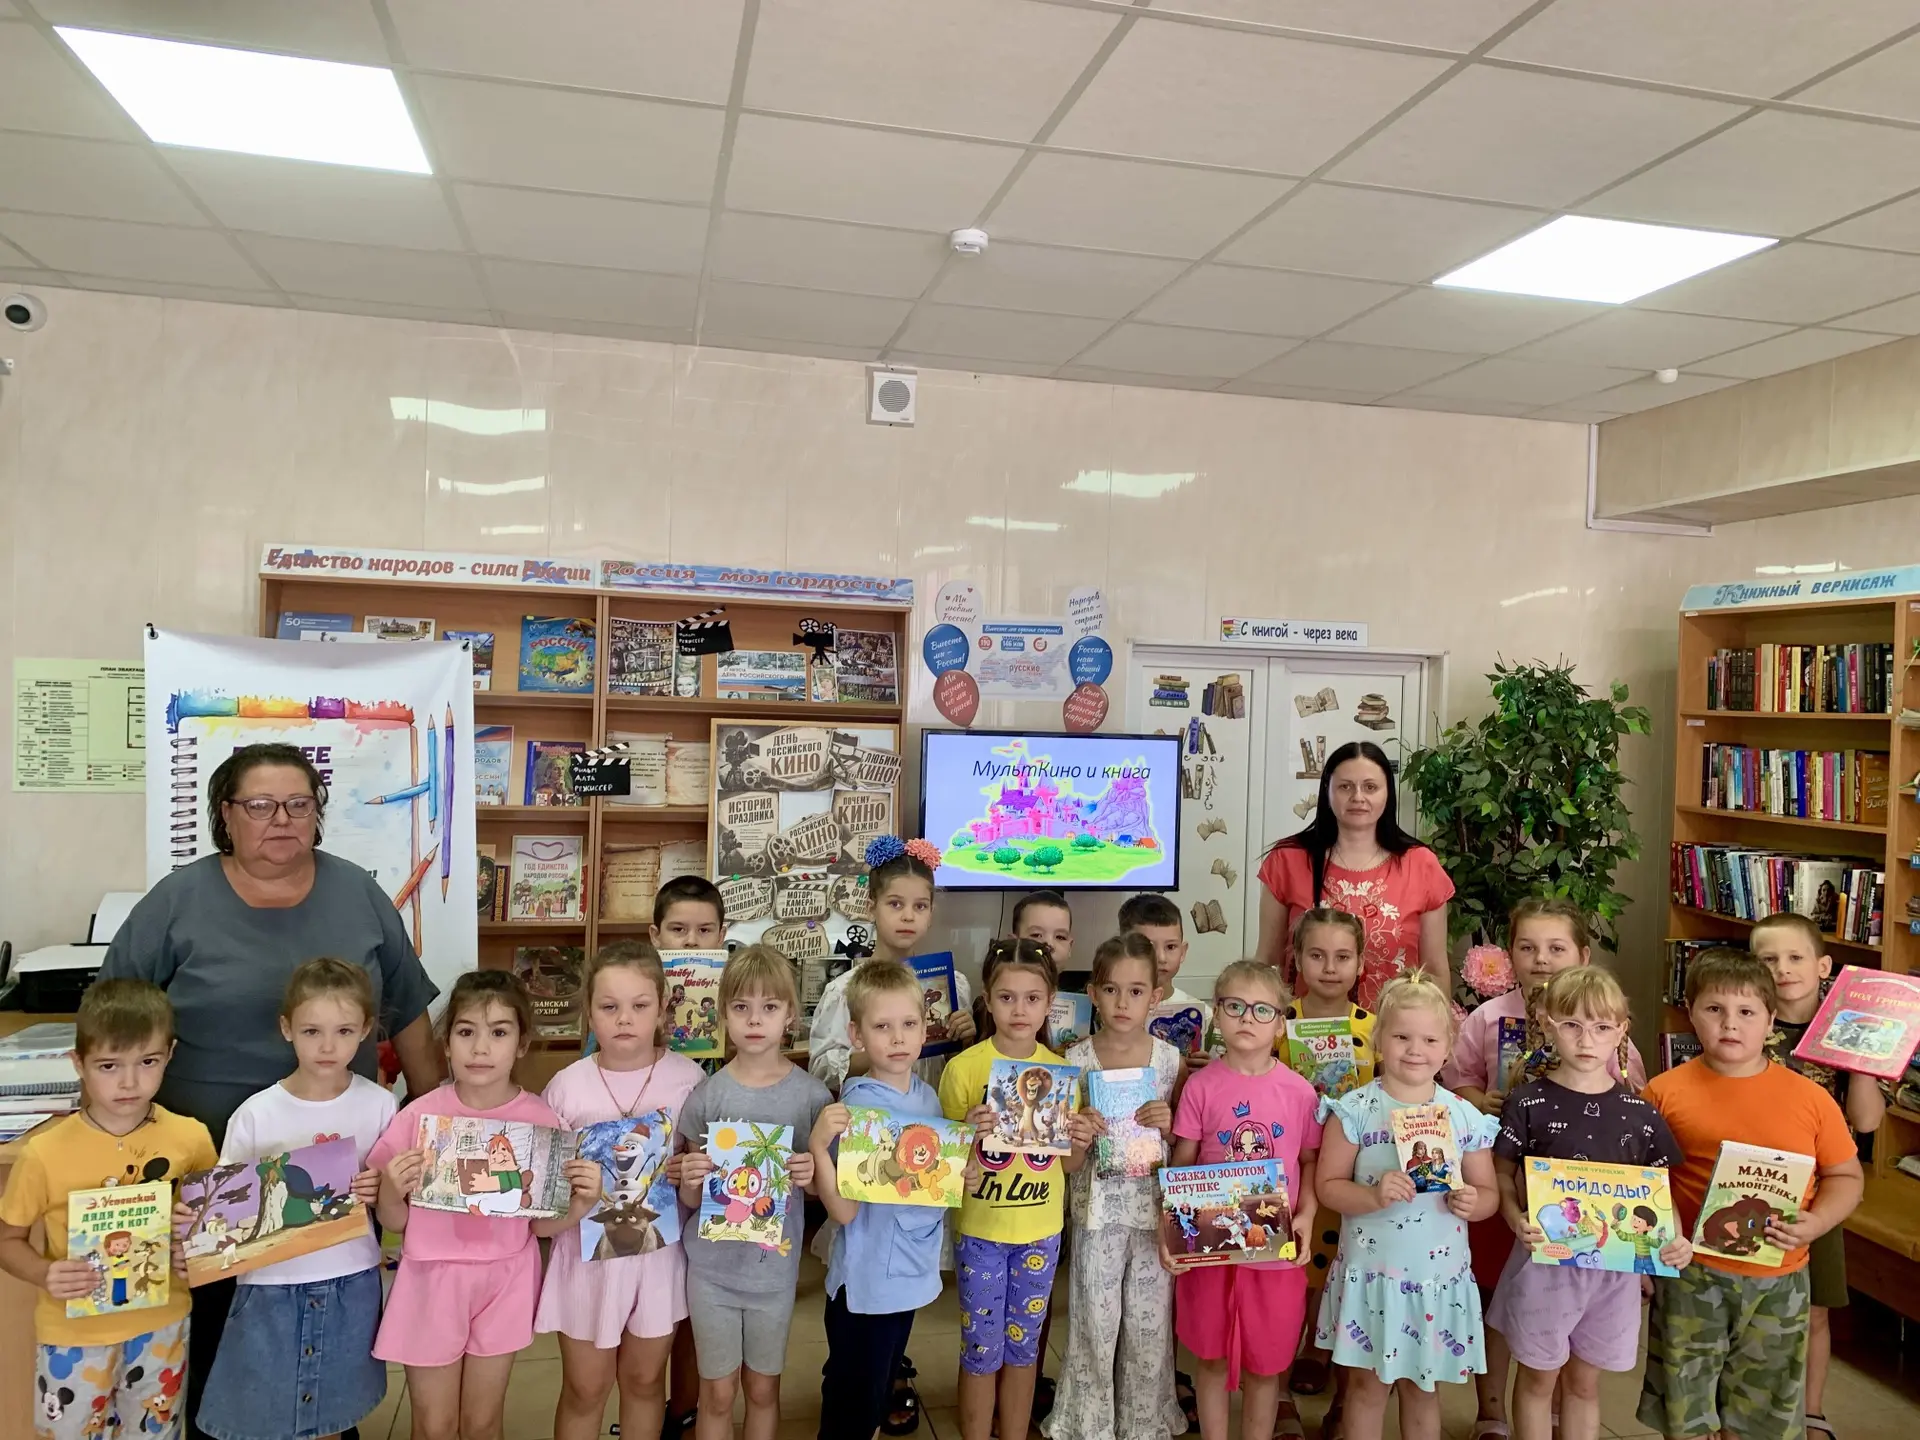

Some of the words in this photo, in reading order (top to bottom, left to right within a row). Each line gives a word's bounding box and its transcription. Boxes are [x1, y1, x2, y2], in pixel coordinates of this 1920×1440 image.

[266, 548, 363, 571] Единство
[368, 557, 454, 577] народов
[471, 561, 518, 577] сила
[522, 560, 591, 582] России
[602, 561, 696, 580] Россия
[718, 571, 769, 584] моя
[776, 574, 896, 592] гордость!
[285, 617, 301, 627] 50
[1240, 621, 1249, 636] С
[1252, 622, 1289, 638] книгой
[1303, 627, 1332, 643] через
[1335, 629, 1358, 641] века
[529, 637, 588, 652] РОССИИ
[773, 732, 798, 747] ДЕНЬ
[766, 741, 822, 757] РОССИЙСКОГО
[770, 753, 821, 776] КИНО
[972, 760, 1082, 779] МультКино
[1086, 767, 1096, 778] и
[1101, 766, 1151, 779] книга
[856, 763, 900, 785] КИНО!
[728, 797, 772, 814] ИСТОРИЯ
[843, 795, 871, 805] ПОЧЕМУ
[728, 808, 775, 825] ПРАЗДНИКА
[838, 803, 886, 825] КИНО
[789, 815, 830, 839] РОССИЙСКОЕ
[850, 822, 879, 832] ВАЖНО
[794, 823, 838, 854] КИНО
[537, 863, 569, 871] ЕДИНСТВА
[786, 898, 816, 907] КАМЕРА!
[787, 891, 813, 899] МОТОР!
[781, 905, 822, 917] НАЧАЛИ!
[774, 928, 807, 942] Кино
[786, 935, 822, 951] МАГИЯ
[665, 968, 696, 979] Шайбу!
[531, 1000, 569, 1008] БАНСКАЯ
[1403, 1120, 1439, 1130] Спящая
[1547, 1121, 1569, 1129] JUST
[1399, 1129, 1446, 1144] красавица
[1166, 1169, 1207, 1183] Сказка
[1208, 1169, 1216, 1179] о
[1217, 1165, 1266, 1179] золотом
[1737, 1165, 1789, 1184] МАМА
[971, 1170, 1000, 1201] In
[1005, 1172, 1050, 1201] Love
[1167, 1181, 1220, 1197] петушке
[1552, 1176, 1651, 1200] МОЙДОДЫР
[1718, 1181, 1798, 1204] МАМОНТЁНКА
[86, 1197, 100, 1211] Э.
[101, 1191, 157, 1207] Успенский
[81, 1210, 115, 1223] ДЯДЯ
[116, 1221, 124, 1230] И
[127, 1217, 149, 1229] КОТ
[972, 1342, 990, 1354] NOT
